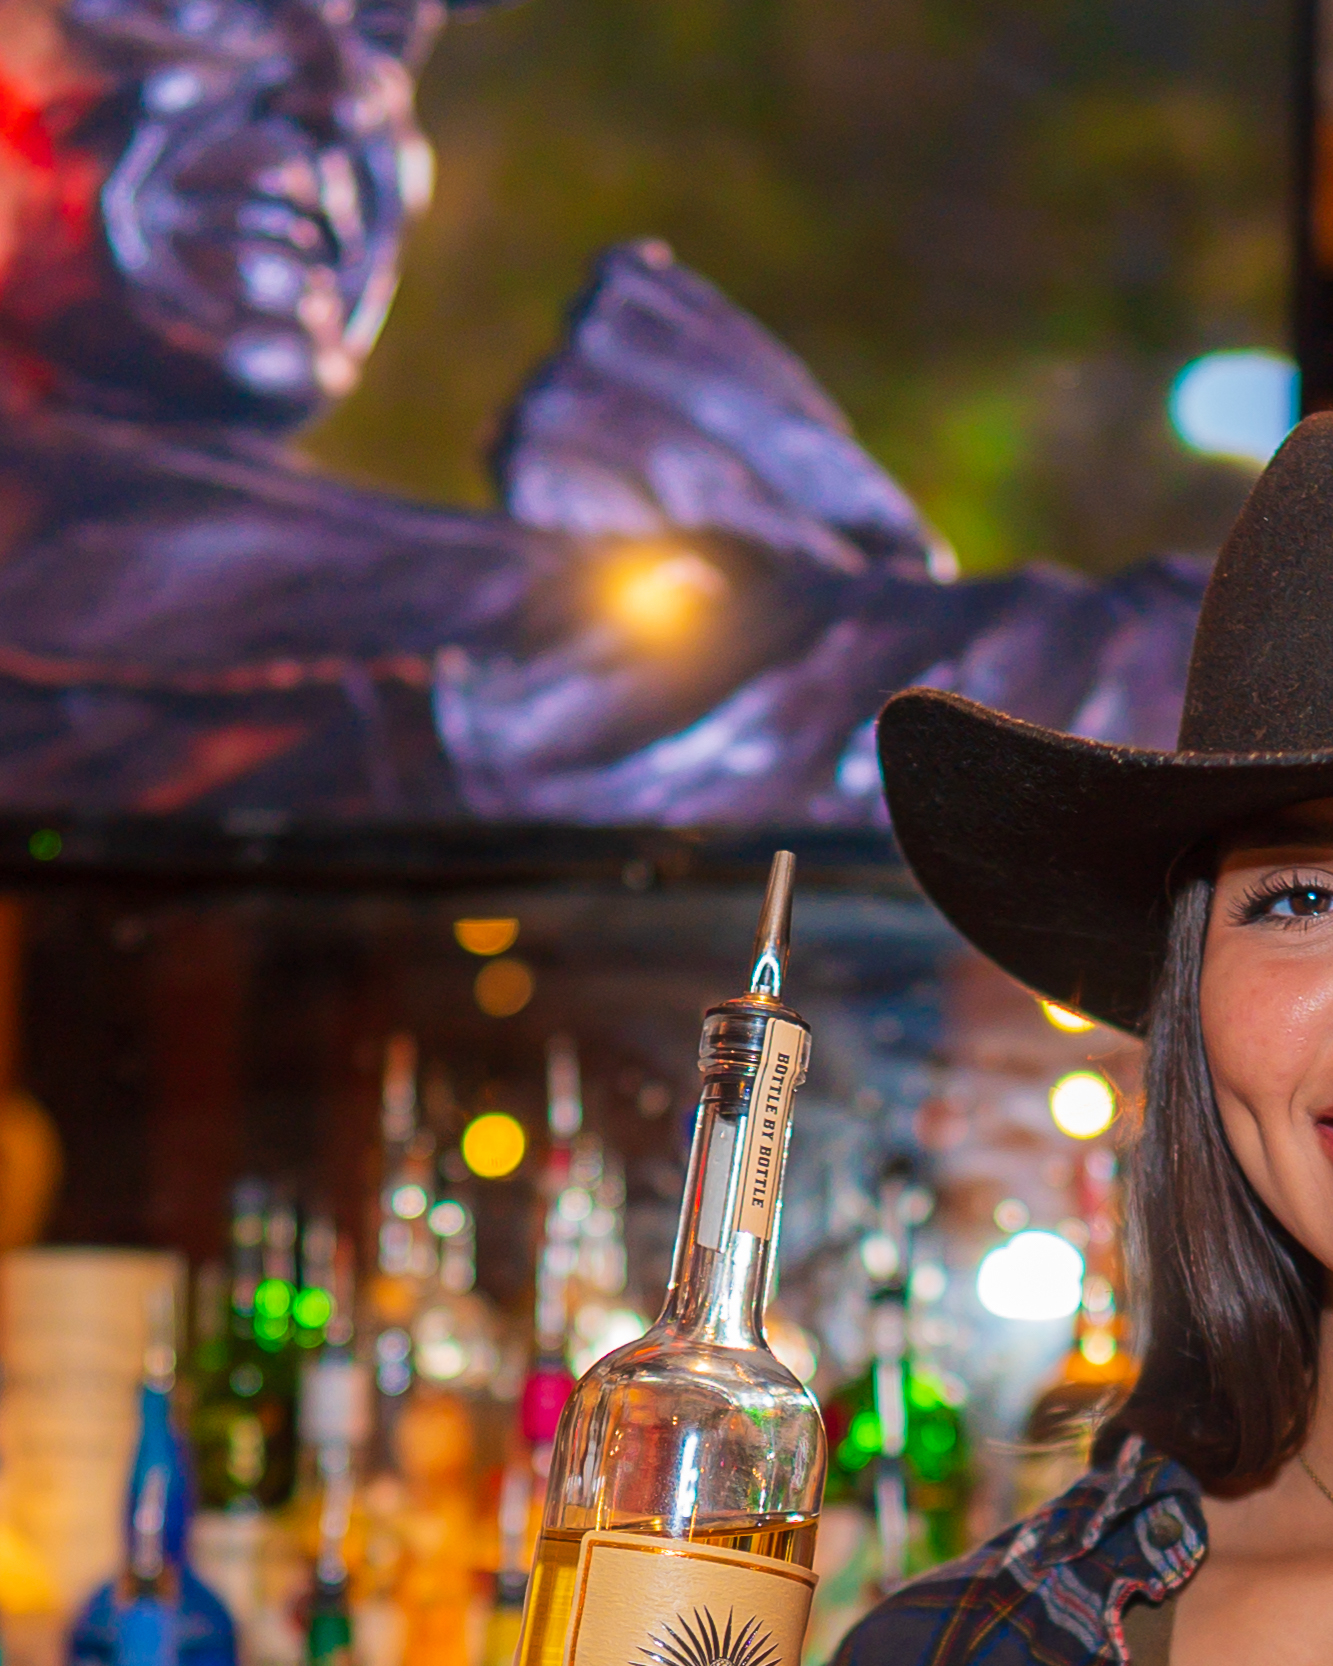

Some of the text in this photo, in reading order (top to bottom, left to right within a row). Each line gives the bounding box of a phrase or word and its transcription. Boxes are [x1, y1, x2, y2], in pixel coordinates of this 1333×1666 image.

[751, 1052, 790, 1208] BOTTLE BY BOTTLE
